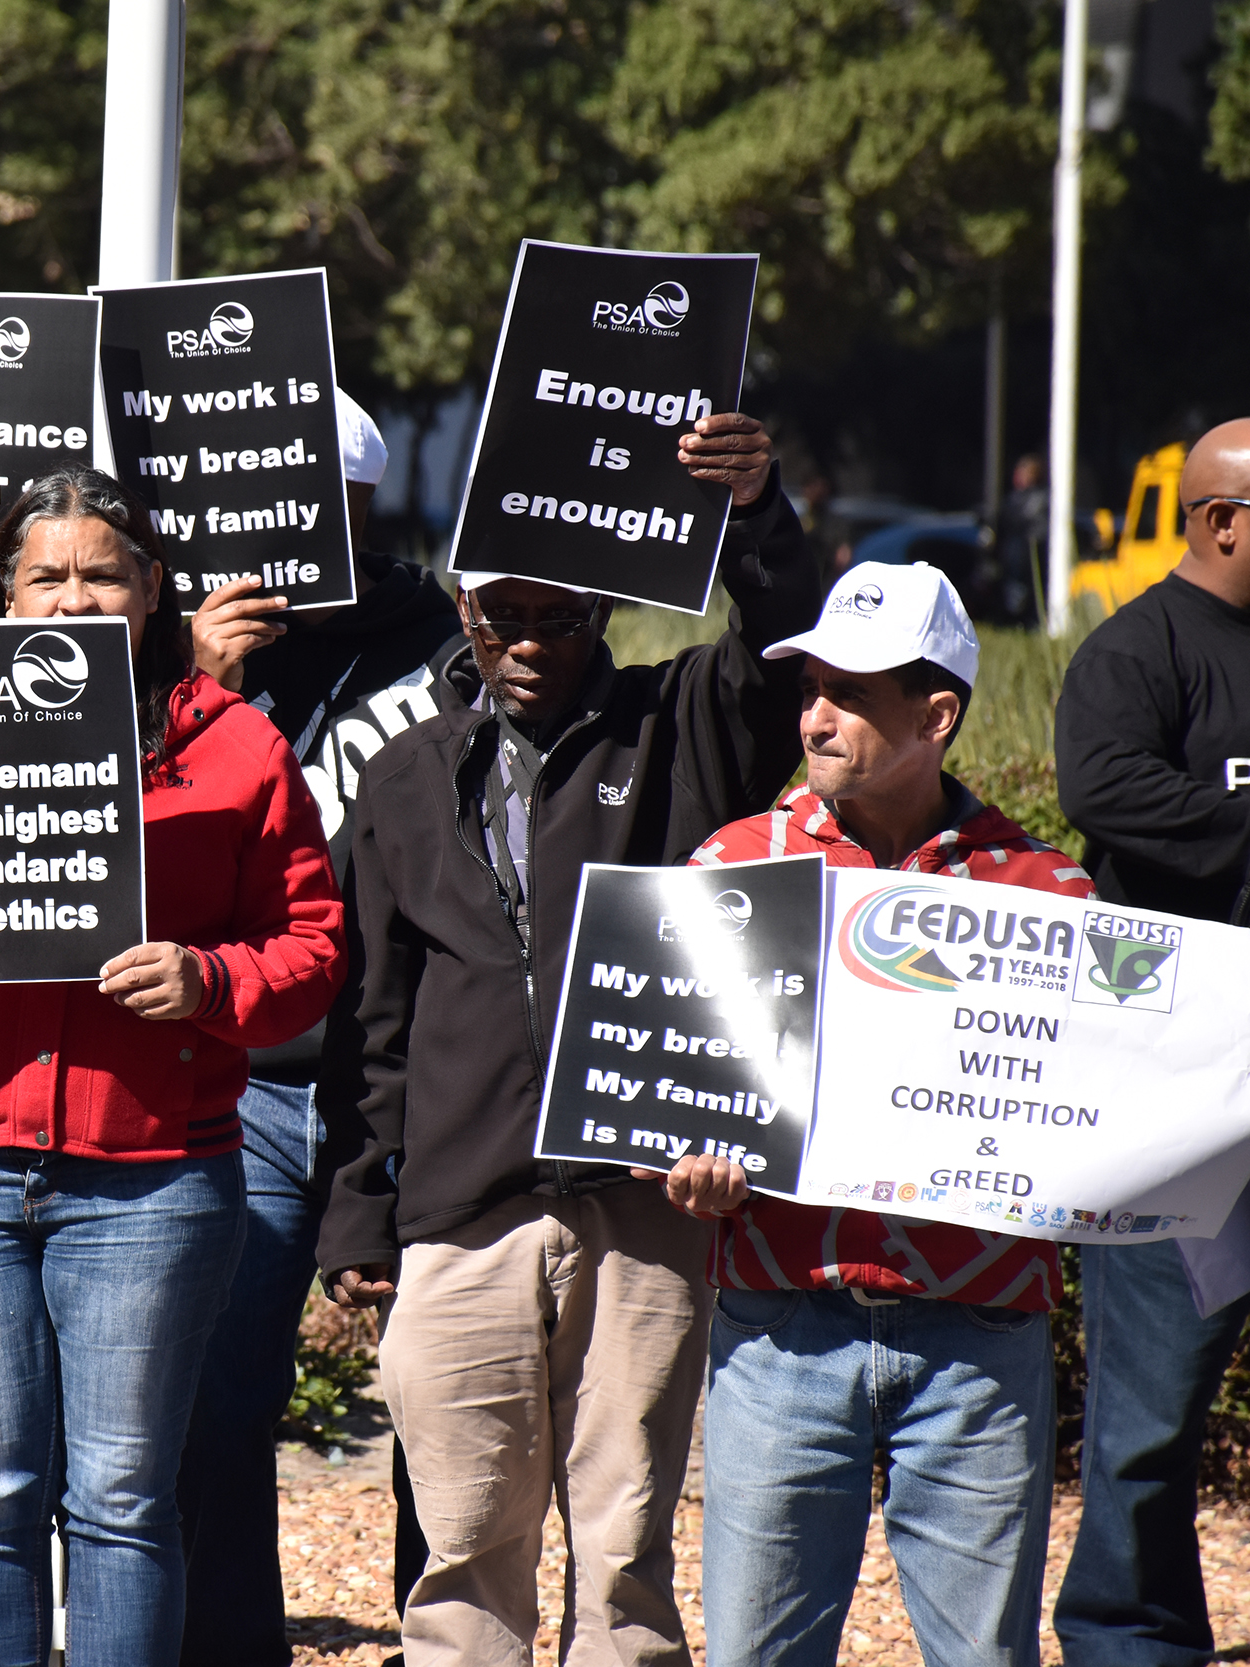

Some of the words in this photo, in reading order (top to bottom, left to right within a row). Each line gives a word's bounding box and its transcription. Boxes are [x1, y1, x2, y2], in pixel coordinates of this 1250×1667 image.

[592, 321, 608, 329] The
[611, 324, 635, 333] Union
[651, 328, 680, 337] Choice
[593, 301, 645, 327] PSA
[167, 329, 217, 352] PSA
[224, 346, 251, 354] Choice
[0, 361, 23, 369] Choice
[123, 390, 172, 423] My
[182, 381, 277, 414] work
[287, 378, 320, 405] is
[535, 368, 713, 427] Enough
[138, 454, 188, 482] my
[200, 438, 317, 474] bread.
[589, 438, 631, 471] is
[149, 508, 196, 541] My
[205, 500, 320, 534] family
[501, 491, 695, 545] enough!
[168, 571, 193, 592] s
[262, 559, 321, 588] life
[13, 711, 30, 723] Of
[34, 710, 83, 722] Choice
[890, 899, 1076, 959] FEDUSA
[1084, 912, 1182, 947] FEDUSA
[591, 963, 650, 998] My
[661, 972, 761, 999] wok
[773, 969, 805, 997] is
[966, 953, 1005, 983] 21
[1009, 958, 1070, 980] YEARS
[591, 1021, 652, 1052] my
[662, 1028, 788, 1059] brea.
[953, 1007, 1060, 1043] DOWN
[959, 1050, 1043, 1084] WITH
[585, 1068, 645, 1102] My
[656, 1078, 782, 1125] family
[890, 1085, 1100, 1127] CORRUPTION
[582, 1119, 618, 1144] is
[630, 1128, 692, 1159] my
[975, 1136, 1000, 1157] &
[930, 1169, 1034, 1198] GREED
